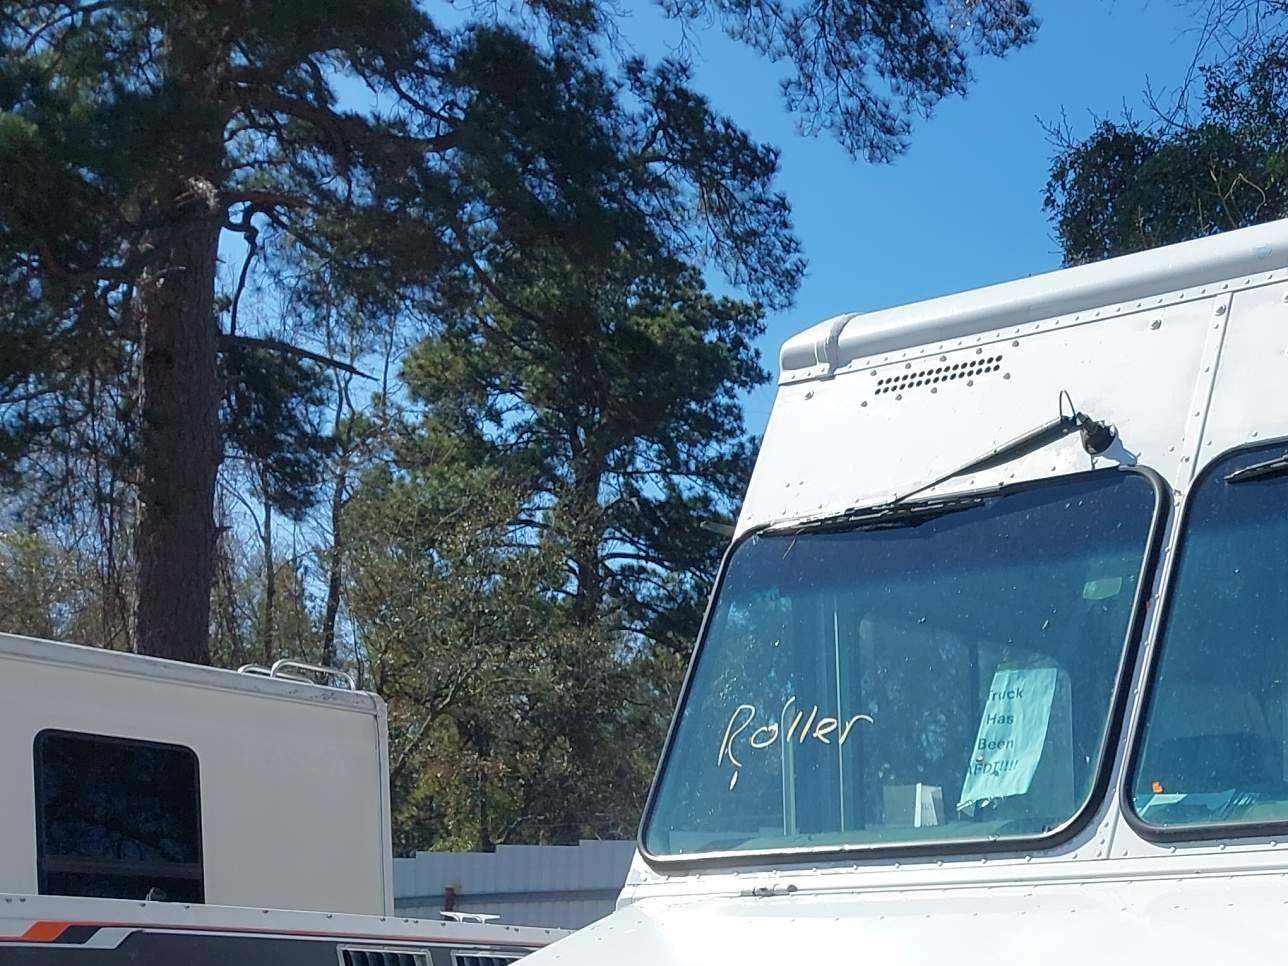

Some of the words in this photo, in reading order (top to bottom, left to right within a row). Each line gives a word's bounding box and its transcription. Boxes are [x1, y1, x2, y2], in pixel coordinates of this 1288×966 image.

[990, 687, 1025, 701] ruck
[986, 713, 1015, 726] Has
[717, 700, 874, 768] Roller
[977, 737, 1015, 751] Been
